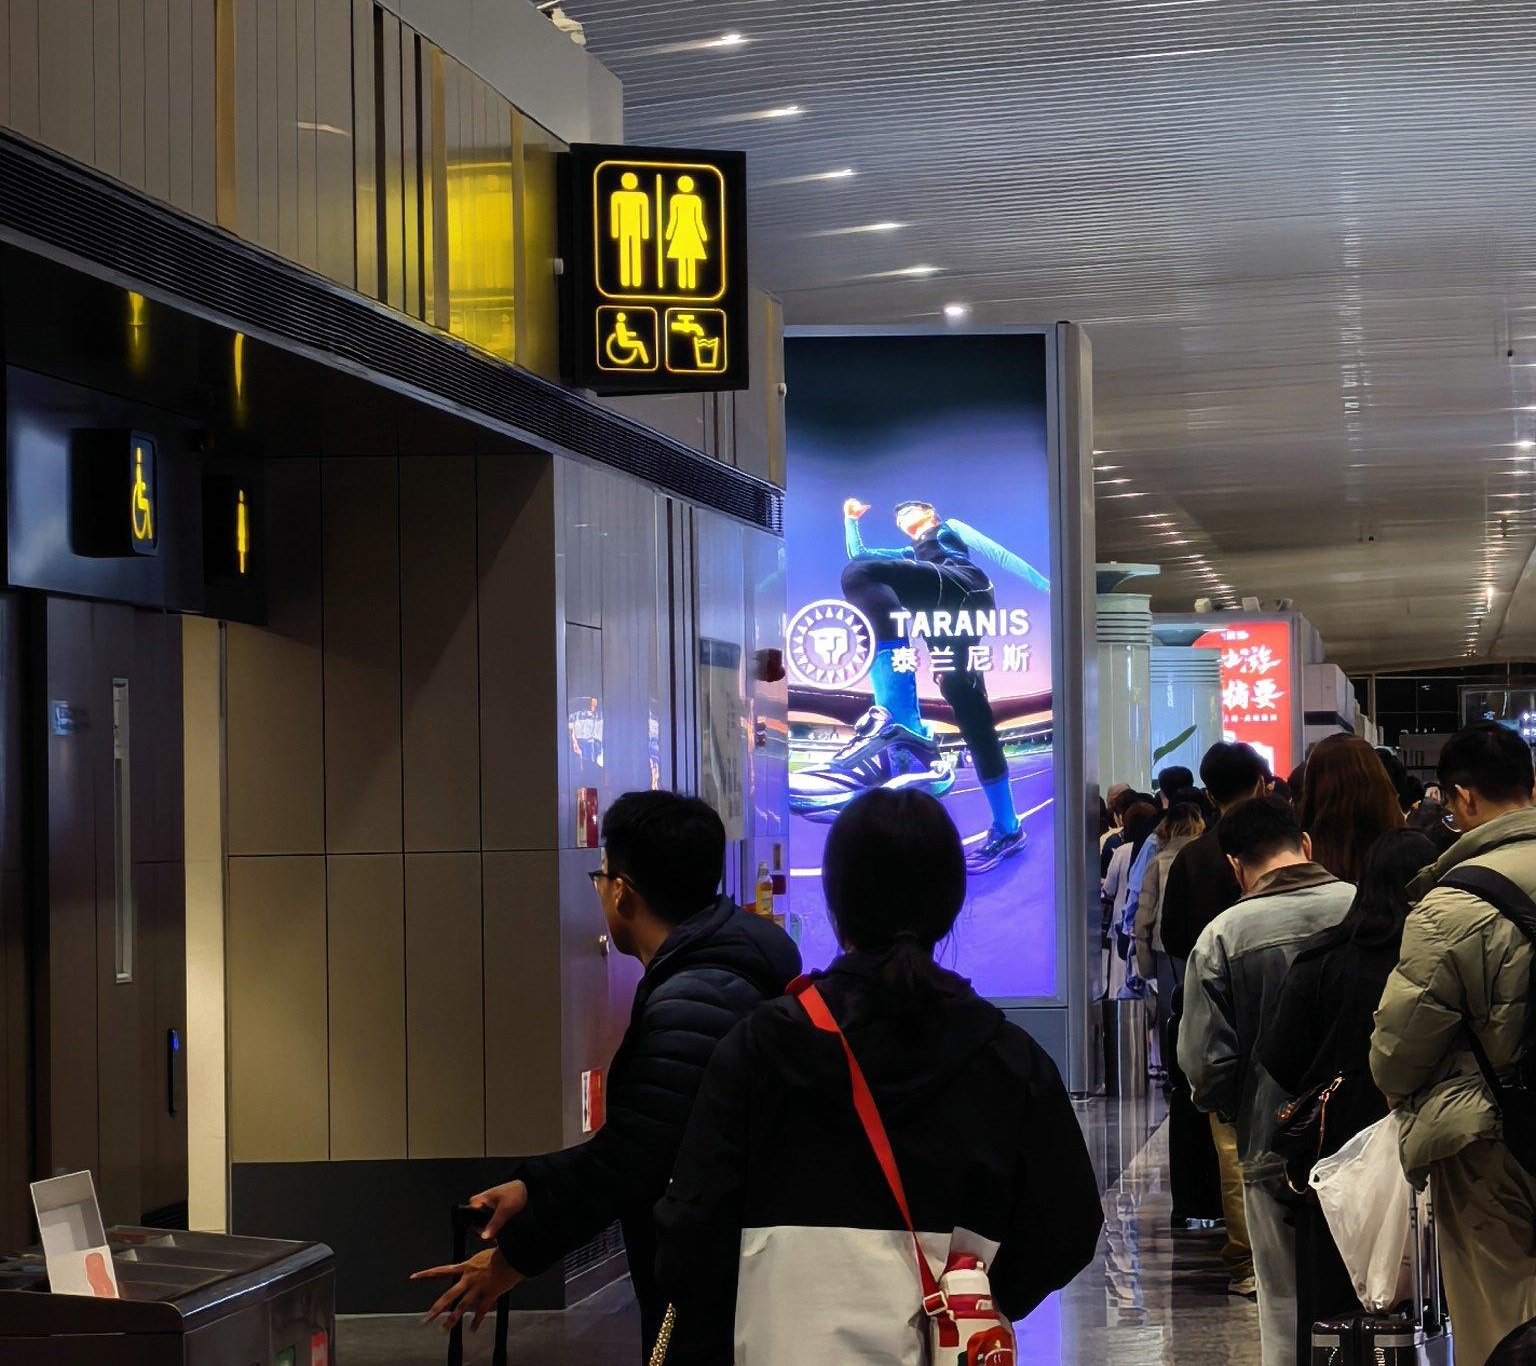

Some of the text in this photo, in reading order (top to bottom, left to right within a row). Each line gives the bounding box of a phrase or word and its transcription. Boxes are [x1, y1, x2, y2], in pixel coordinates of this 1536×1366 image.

[889, 608, 1030, 638] TARANIS
[891, 643, 1030, 673] 泰兰尼斯
